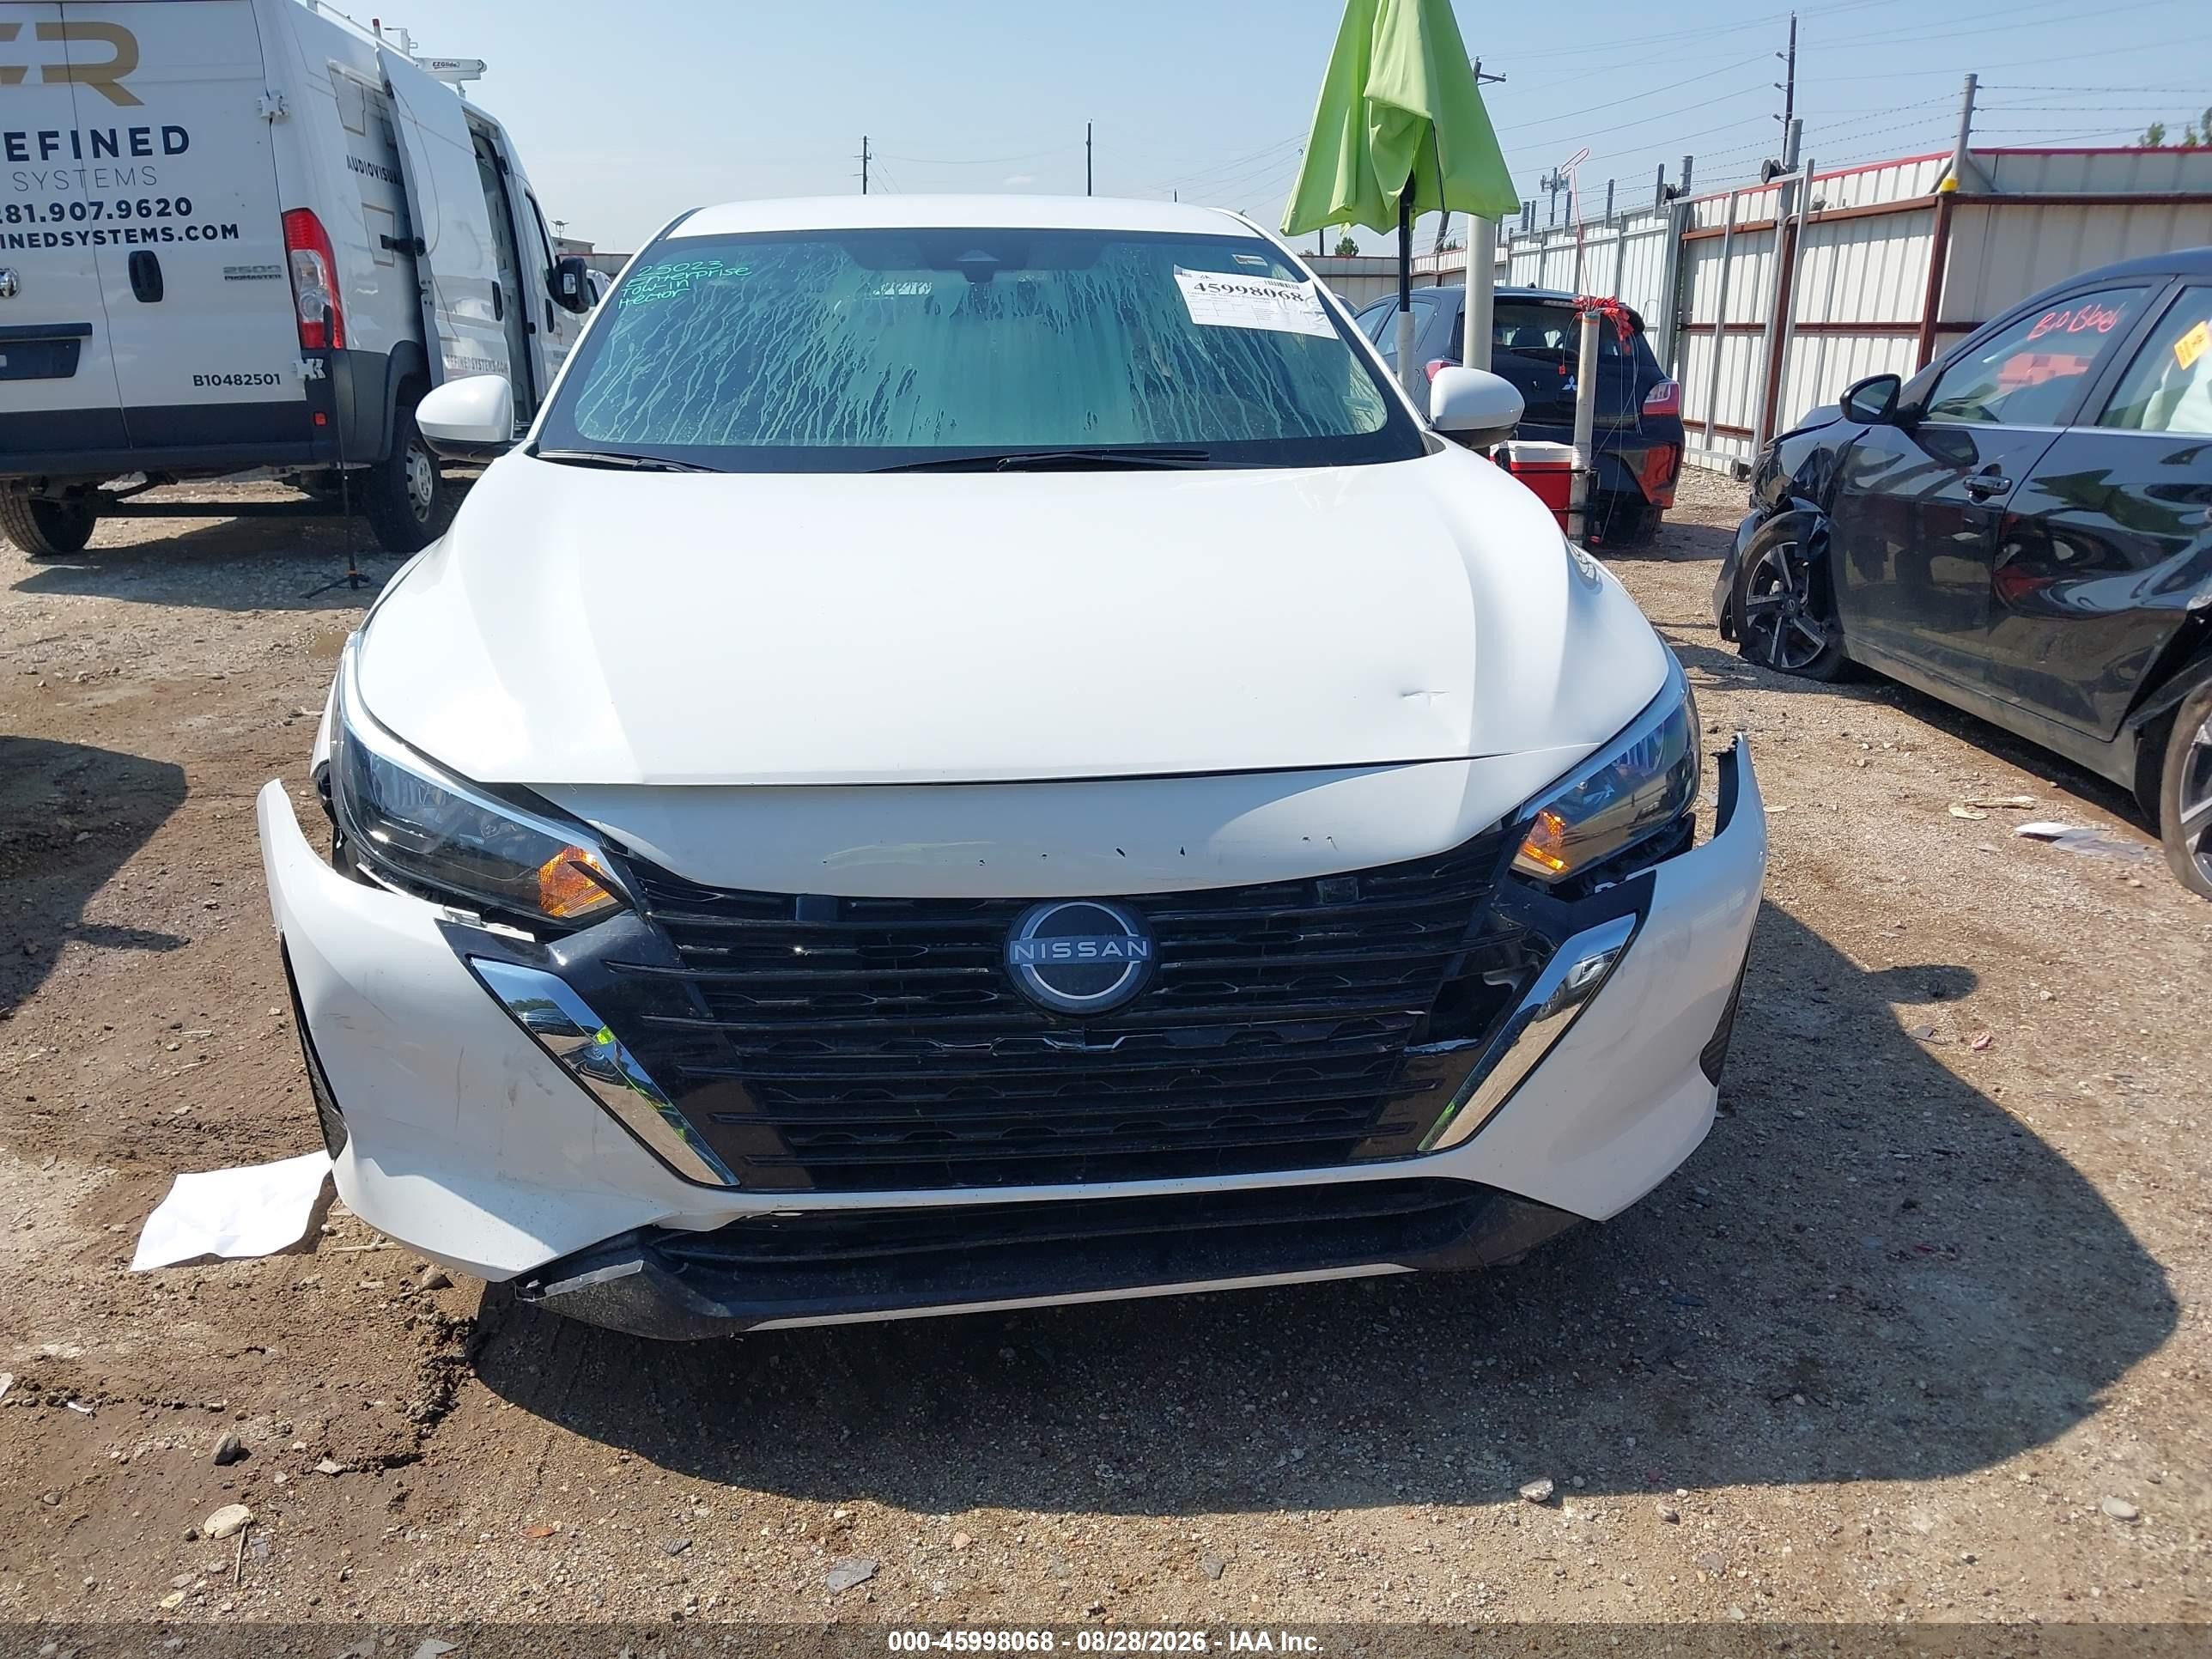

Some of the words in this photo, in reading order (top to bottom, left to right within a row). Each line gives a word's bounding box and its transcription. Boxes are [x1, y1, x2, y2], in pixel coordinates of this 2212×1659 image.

[12, 166, 157, 191] SYSTEMS
[0, 197, 192, 224] 81.907.9620
[626, 267, 752, 288] Enterprise
[636, 260, 723, 277] 25023
[1194, 283, 1304, 302] 45998068
[193, 374, 281, 386] B10482501
[1015, 940, 1147, 961] NISSAN
